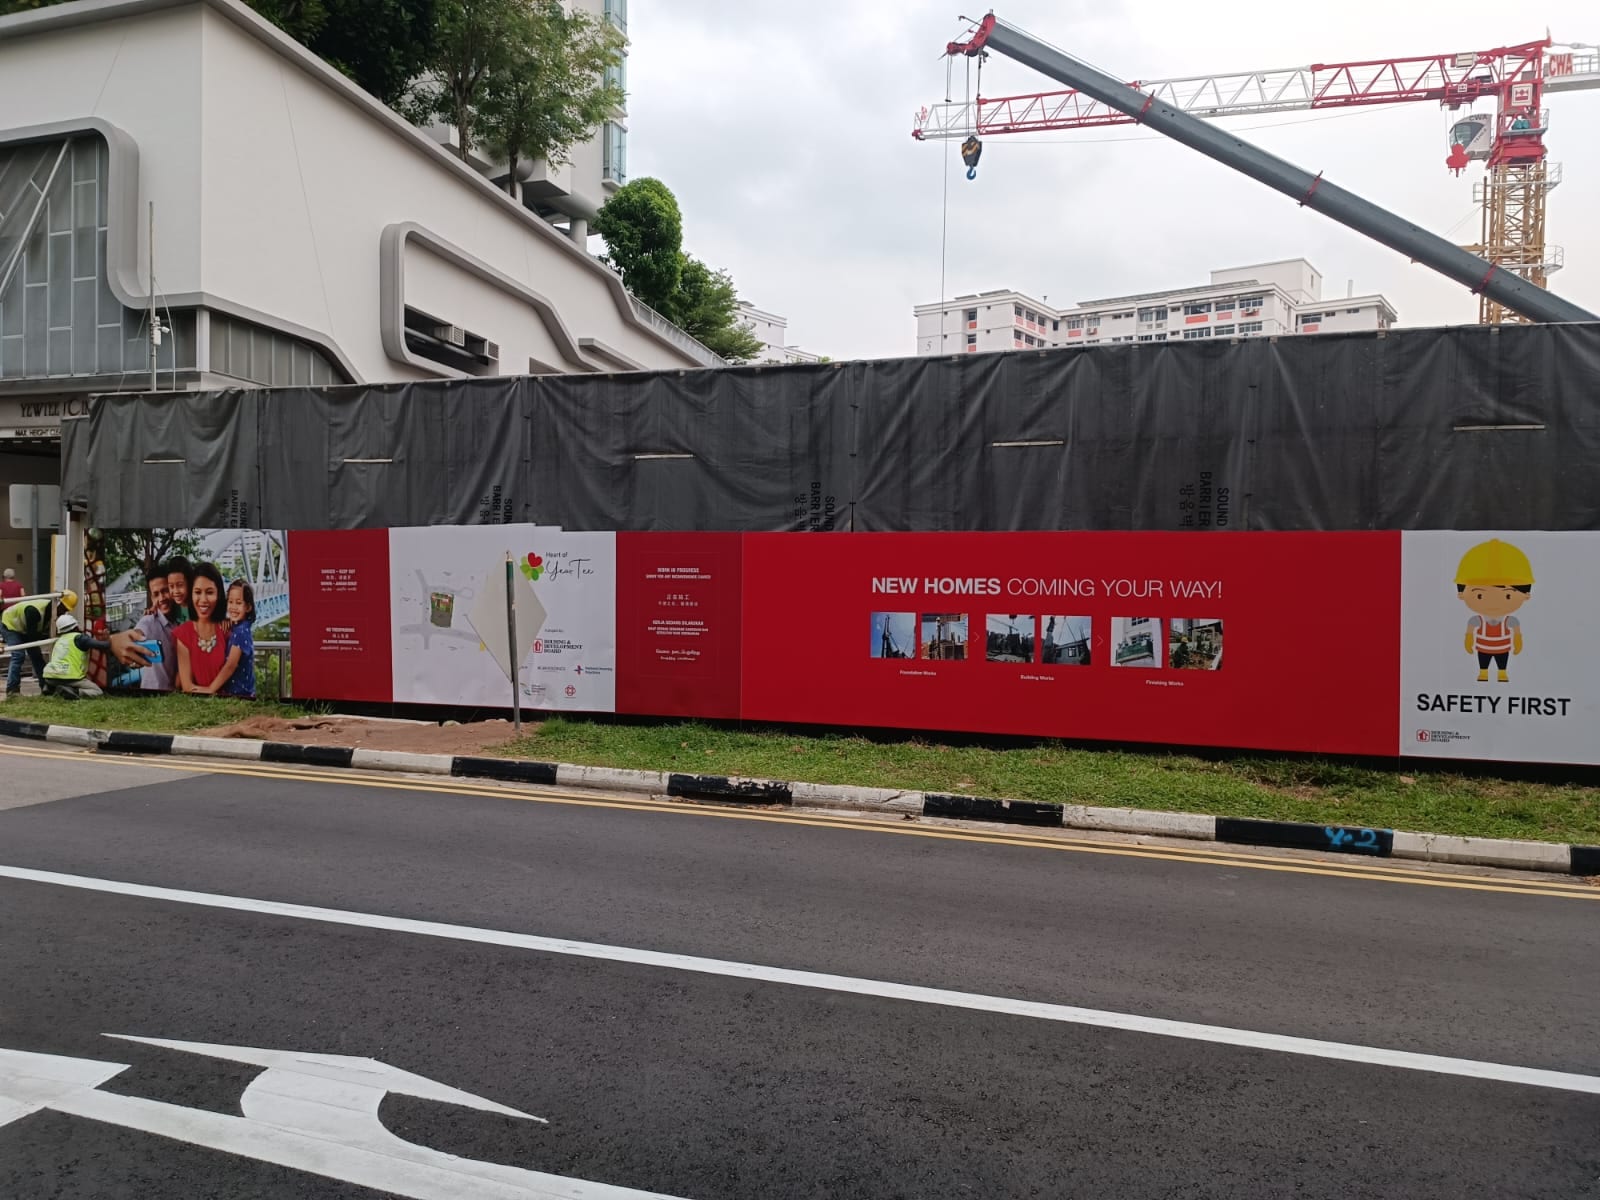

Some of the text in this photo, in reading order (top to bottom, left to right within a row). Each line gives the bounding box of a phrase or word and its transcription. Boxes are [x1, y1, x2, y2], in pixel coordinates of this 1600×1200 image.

[1549, 53, 1573, 77] CWA
[1199, 471, 1212, 527] BARRIER
[1216, 487, 1230, 527] SOUND
[872, 577, 1222, 598] NEW HOMES COMING YOUR WAY!
[1416, 693, 1571, 716] SAFETY FIRST
